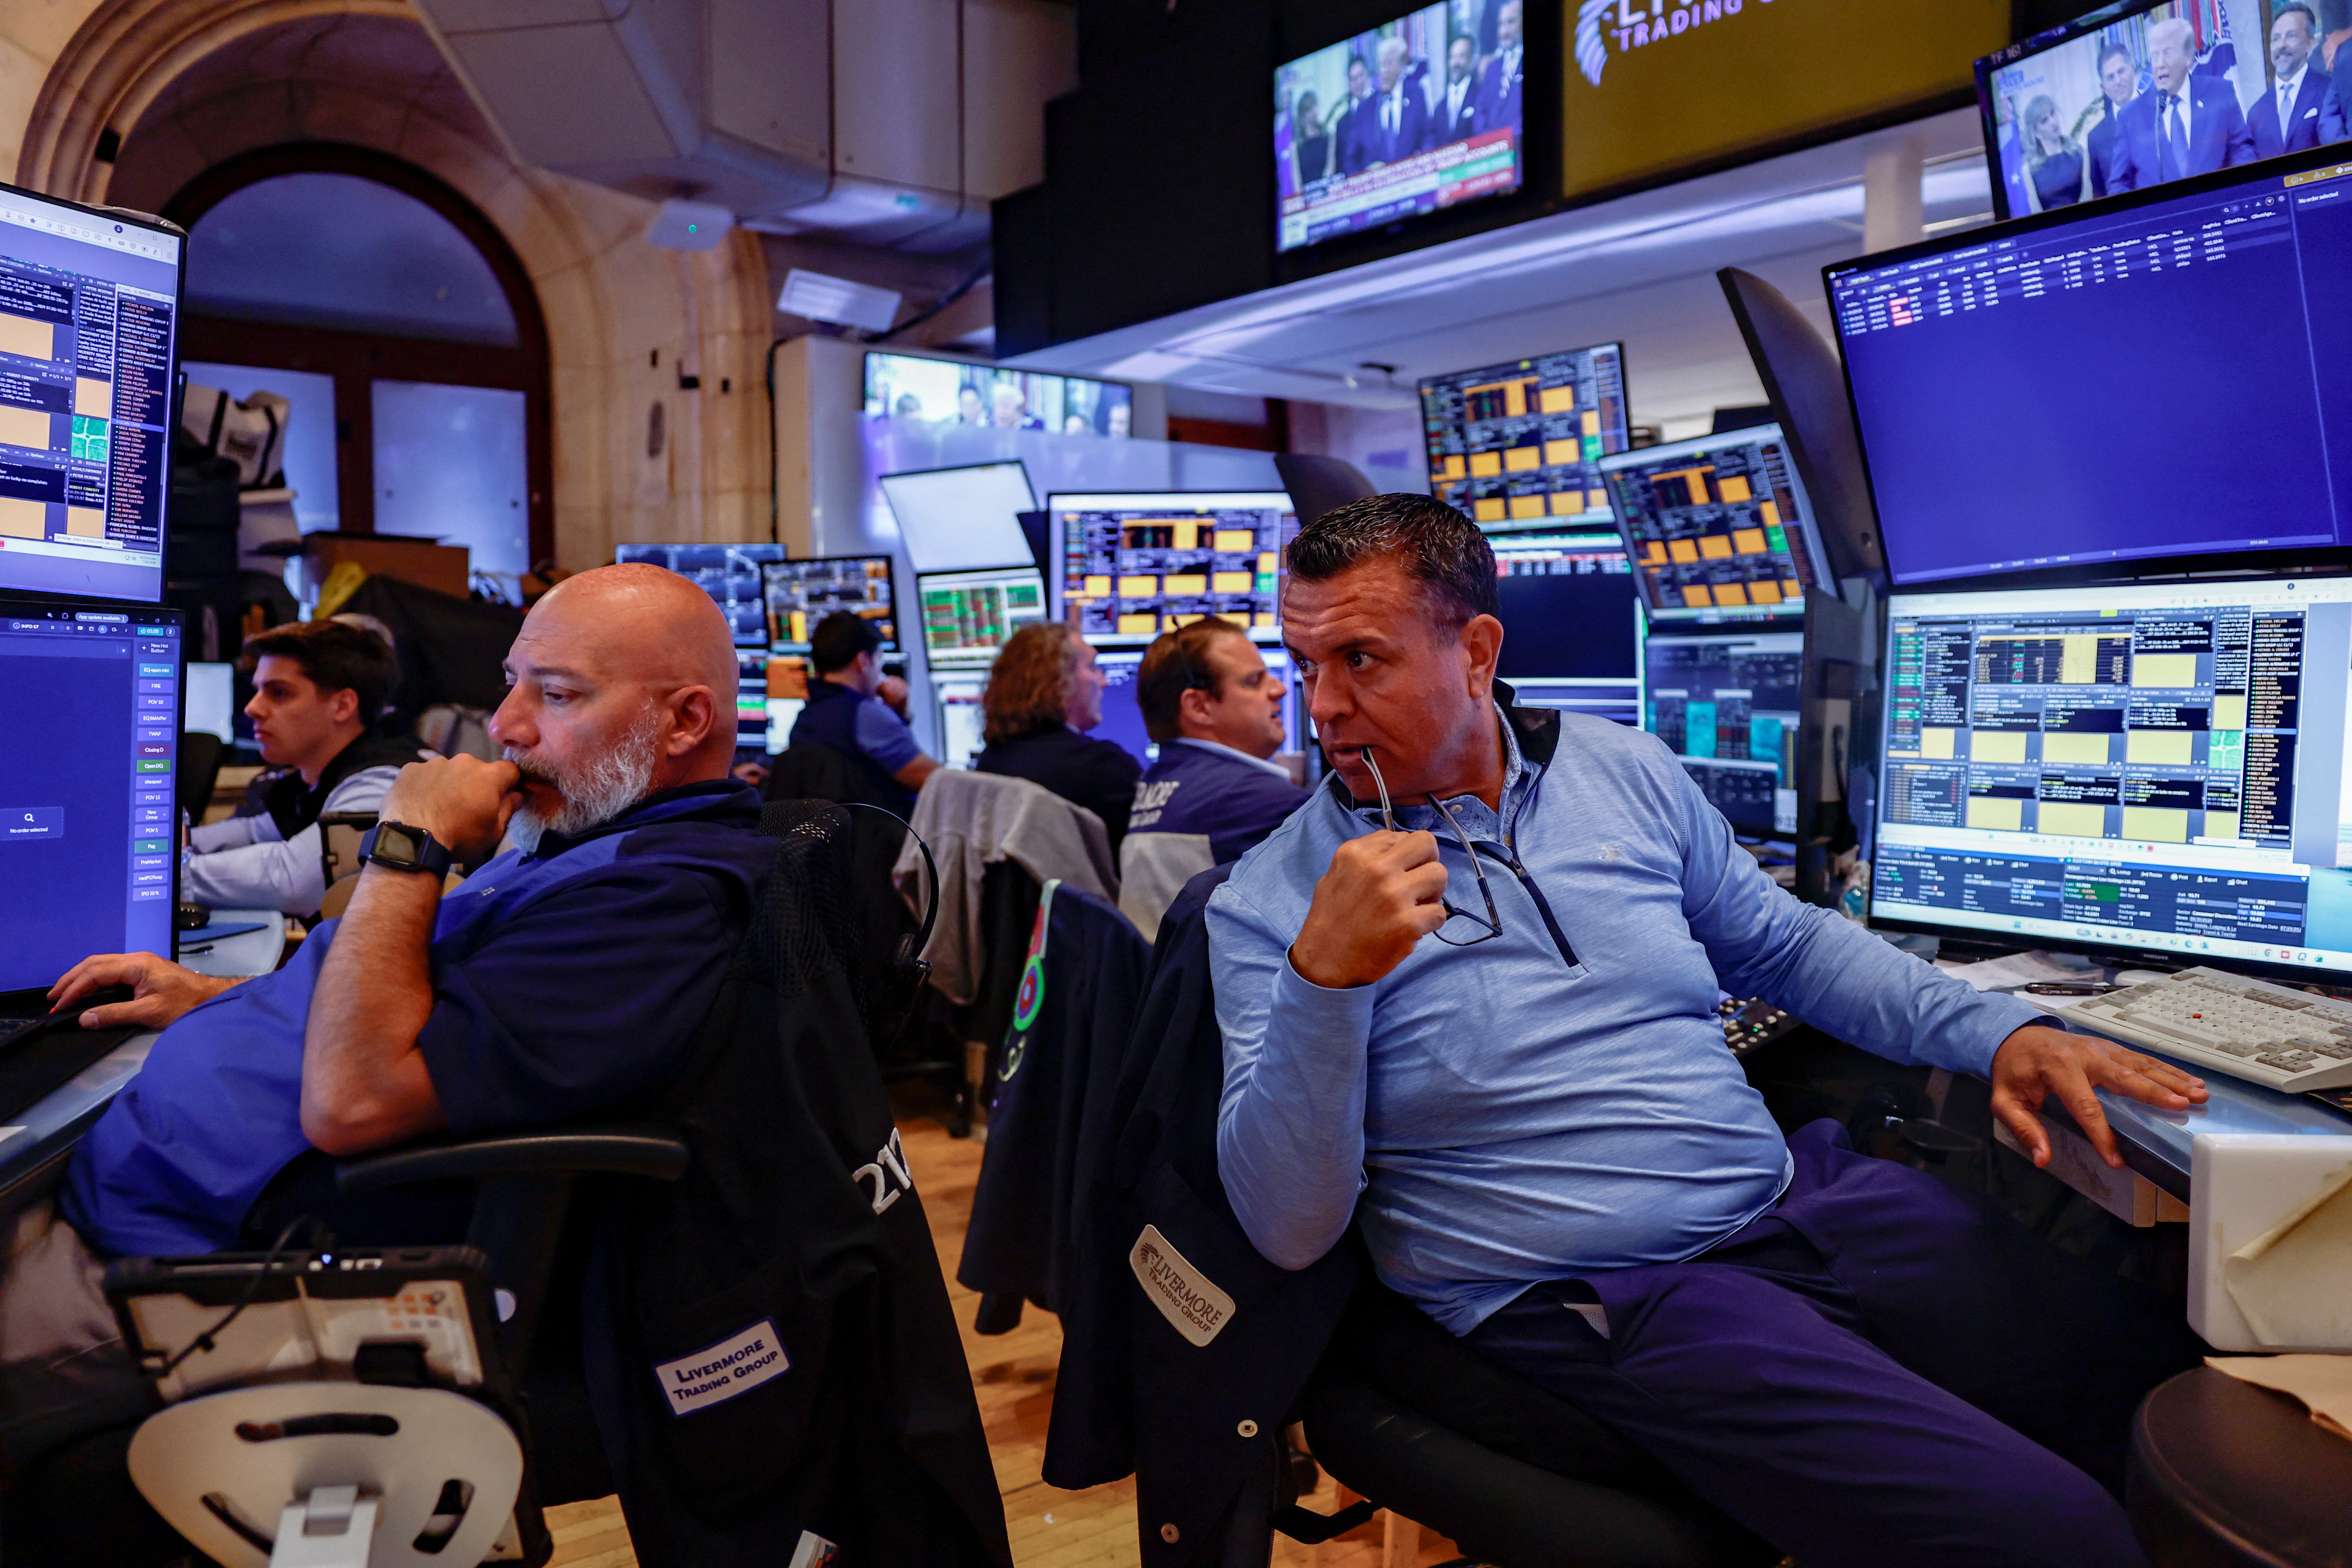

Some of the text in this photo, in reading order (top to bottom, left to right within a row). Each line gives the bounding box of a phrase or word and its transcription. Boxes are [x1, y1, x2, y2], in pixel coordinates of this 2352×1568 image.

[1618, 0, 1742, 52] TRADING
[2319, 191, 2339, 200] selected
[1149, 1268, 1211, 1332] TRADING GROUP
[1153, 1255, 1222, 1325] LIVERMORE
[673, 1350, 779, 1400] TRADING GROUP
[675, 1339, 764, 1383] LIVERMORE
